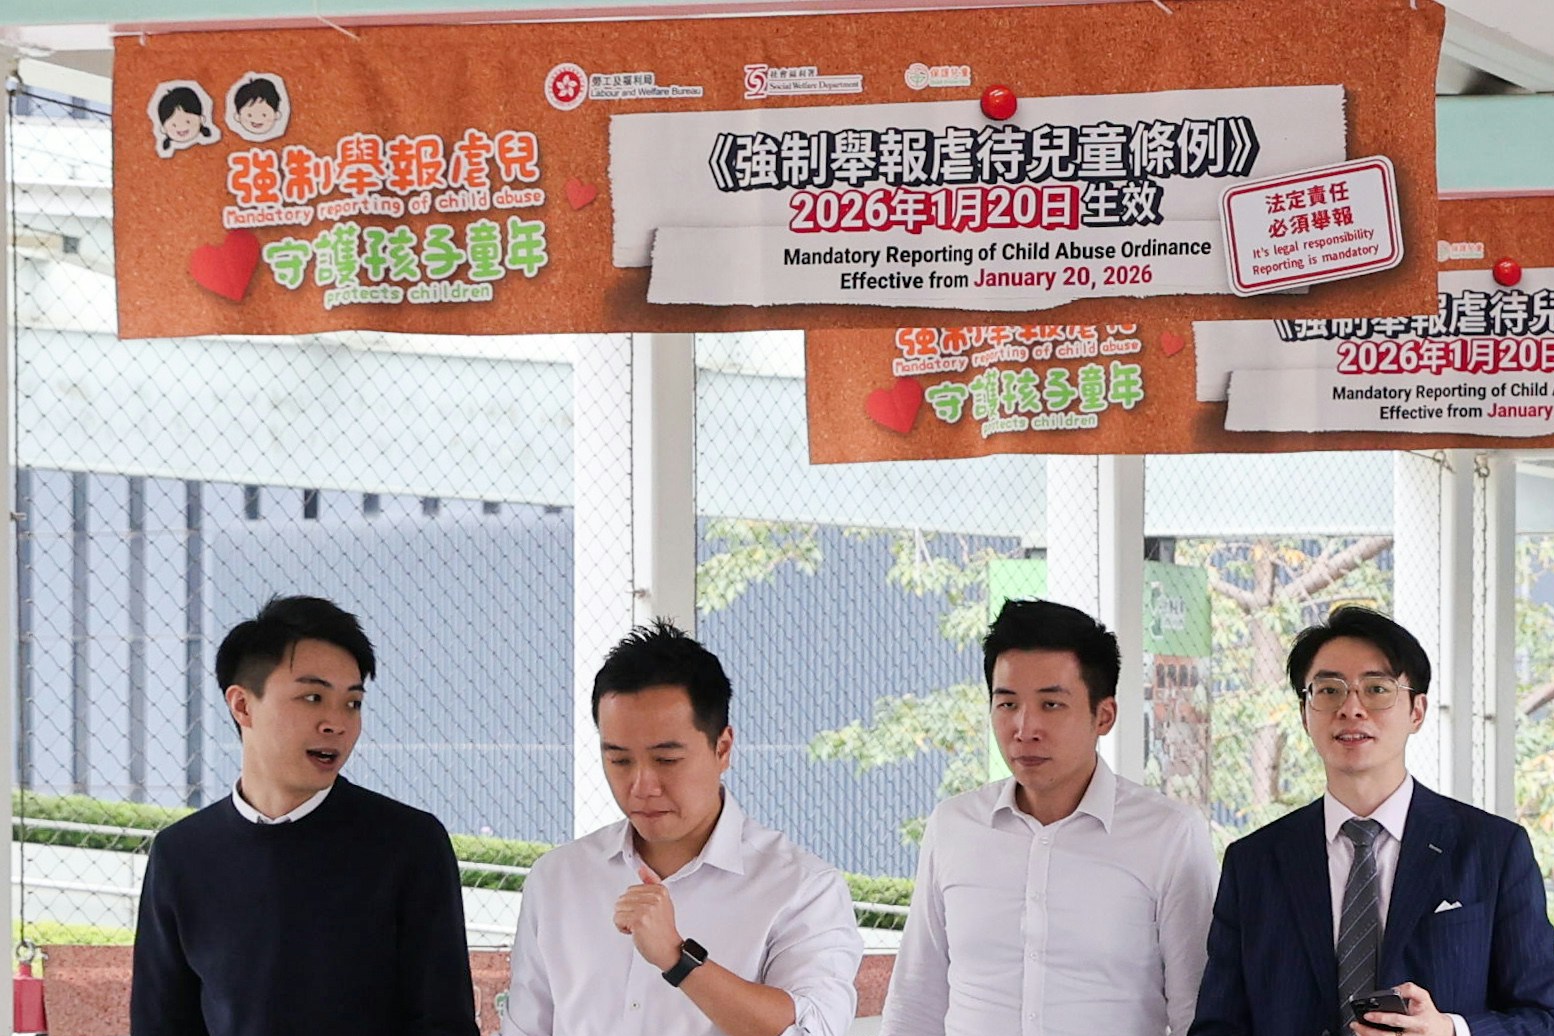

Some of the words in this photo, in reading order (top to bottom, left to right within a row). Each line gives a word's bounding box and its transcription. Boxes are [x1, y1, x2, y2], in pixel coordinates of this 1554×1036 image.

[591, 86, 620, 97] Labour
[622, 86, 636, 96] and
[638, 86, 669, 96] Welfare
[671, 86, 701, 96] Bureau
[592, 74, 652, 86] 勞工及福利局
[231, 131, 538, 203] 強制舉報虐兒
[708, 116, 1261, 192] 《強制舉報虐待兒童條例》
[226, 207, 311, 224] Mandatory
[319, 198, 401, 215] reporting
[411, 196, 428, 211] of
[439, 192, 487, 208] child
[496, 189, 541, 205] abuse
[789, 180, 1164, 234] 2026年1月20日生效
[1265, 180, 1349, 214] 法定責任
[1268, 206, 1354, 238] 必須舉報
[266, 220, 545, 286] 守護孩子童年
[783, 246, 880, 267] Mandatory
[886, 244, 973, 267] Reporting
[978, 242, 997, 261] of
[1002, 242, 1050, 260] Child
[1055, 240, 1116, 260] Abuse
[1121, 239, 1212, 258] Ordinance
[1253, 247, 1270, 259] It's
[1273, 241, 1299, 256] legal
[1303, 229, 1374, 250] responsibility
[1253, 257, 1305, 276] Reporting
[1308, 254, 1318, 265] is
[1322, 244, 1380, 263] mandatory
[840, 271, 924, 290] Effective
[929, 271, 969, 288] from
[974, 267, 1057, 291] January
[1062, 266, 1096, 290] 20,
[1102, 264, 1153, 285] 2026
[327, 287, 401, 305] protects
[410, 284, 490, 300] children
[895, 357, 966, 373] Mandatory
[973, 346, 1027, 366] reporting
[1035, 344, 1051, 358] of
[1058, 342, 1096, 357] child
[1103, 340, 1140, 353] abuse
[927, 363, 1142, 420] 守護孩子童年
[1332, 385, 1412, 402] Mandatory
[1416, 383, 1487, 401] Reporting
[1491, 382, 1506, 397] of
[1511, 379, 1548, 396] Child
[1034, 412, 1096, 429] children
[1380, 405, 1443, 420] Effective
[1447, 403, 1483, 419] from
[1487, 400, 1551, 421] January
